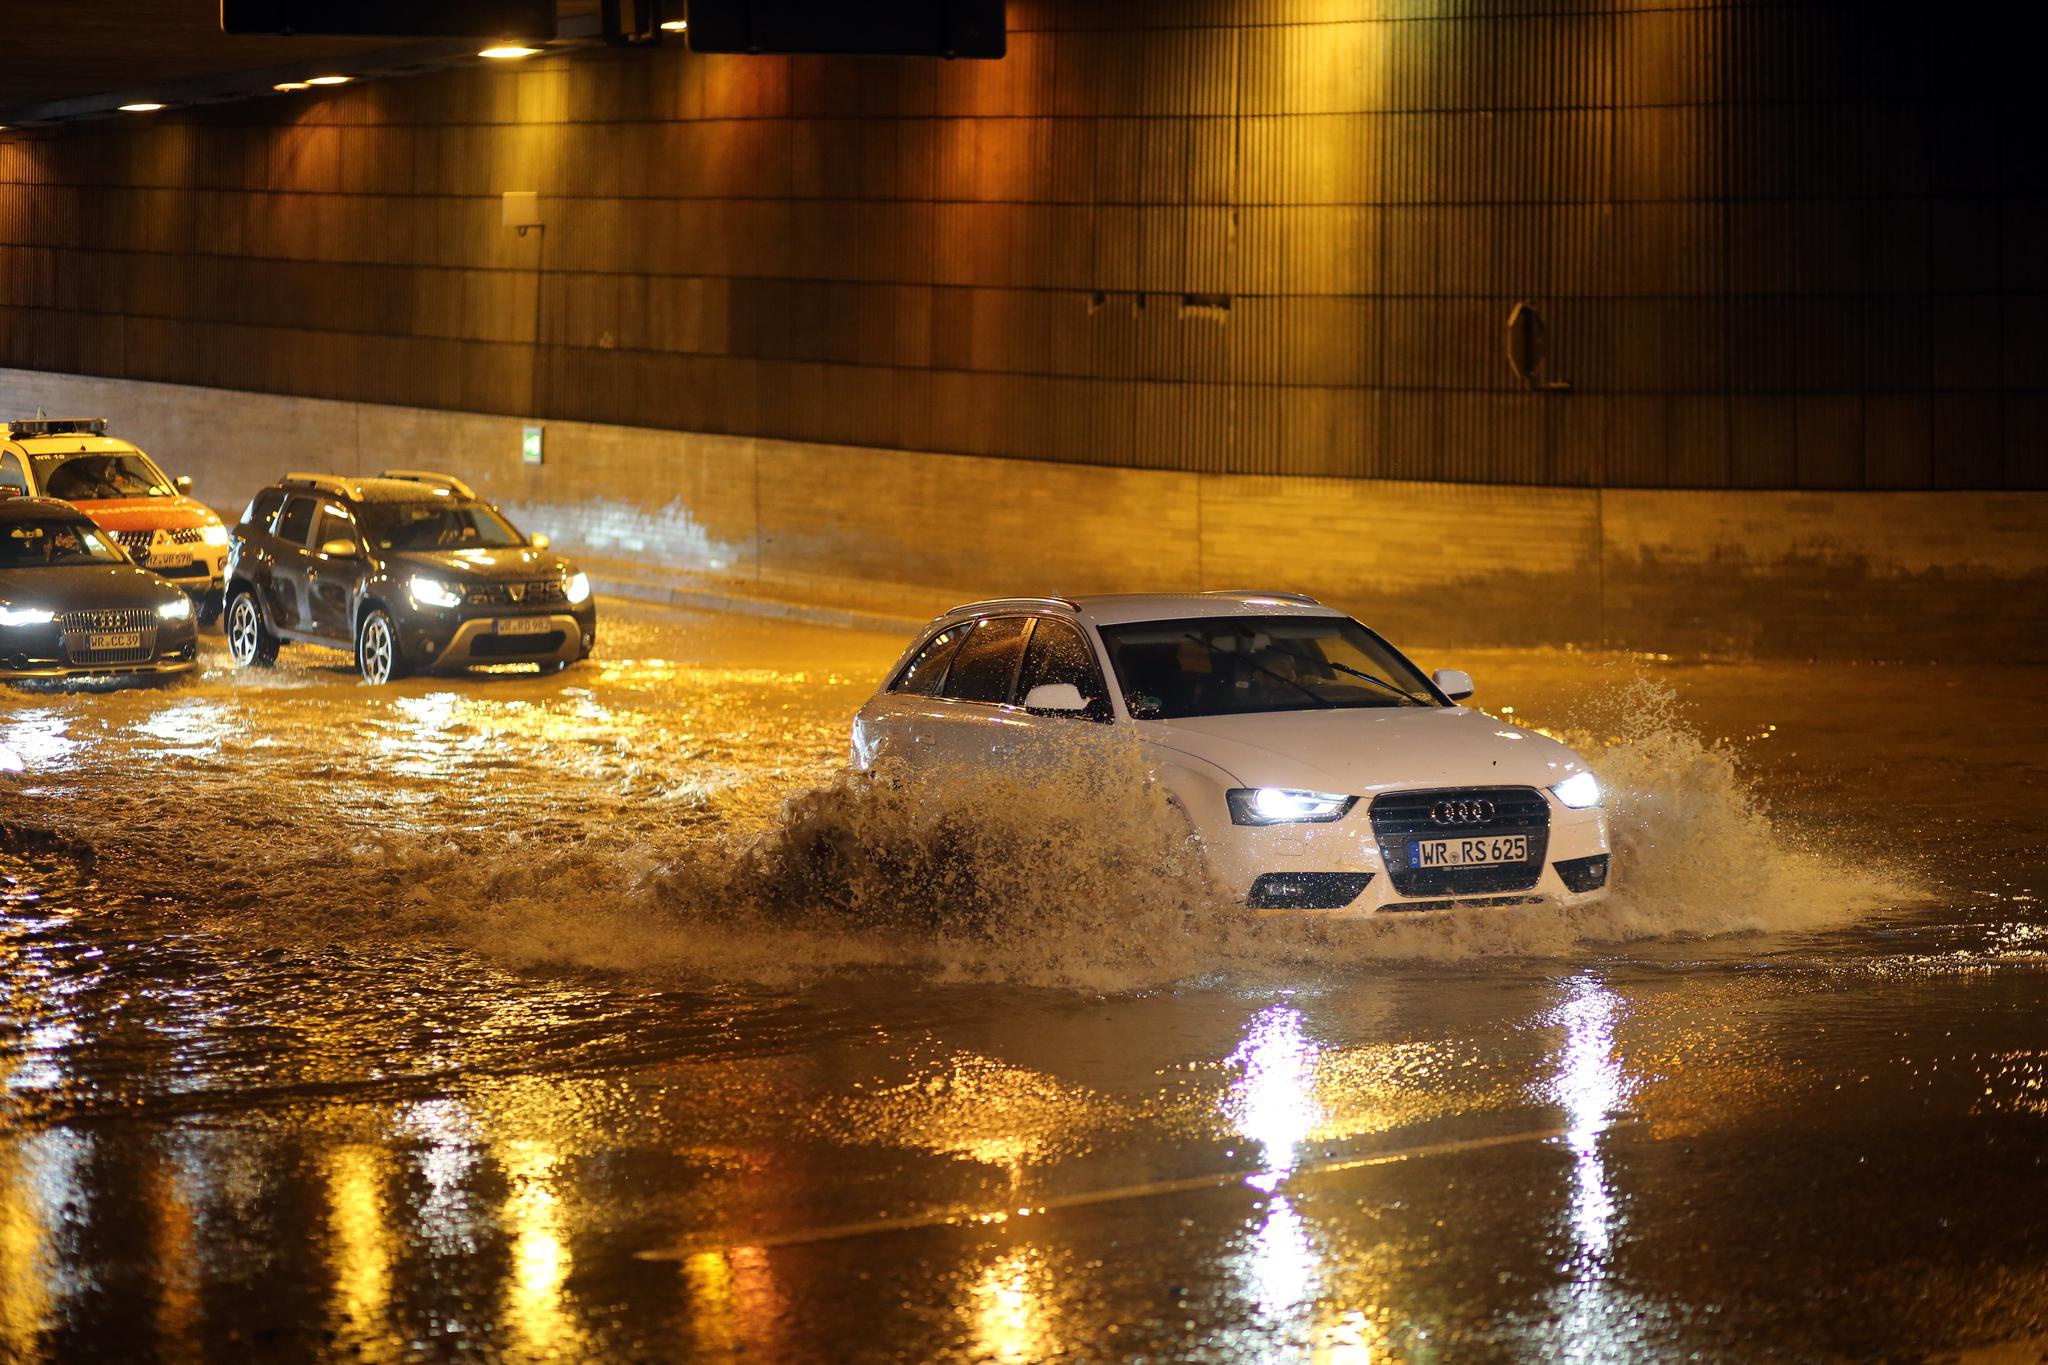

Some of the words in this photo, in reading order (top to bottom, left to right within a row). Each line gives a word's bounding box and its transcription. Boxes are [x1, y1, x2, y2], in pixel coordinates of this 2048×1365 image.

[91, 636, 104, 647] WR
[1421, 843, 1448, 865] WR
[1461, 841, 1487, 863] RS
[1491, 838, 1525, 861] 625
